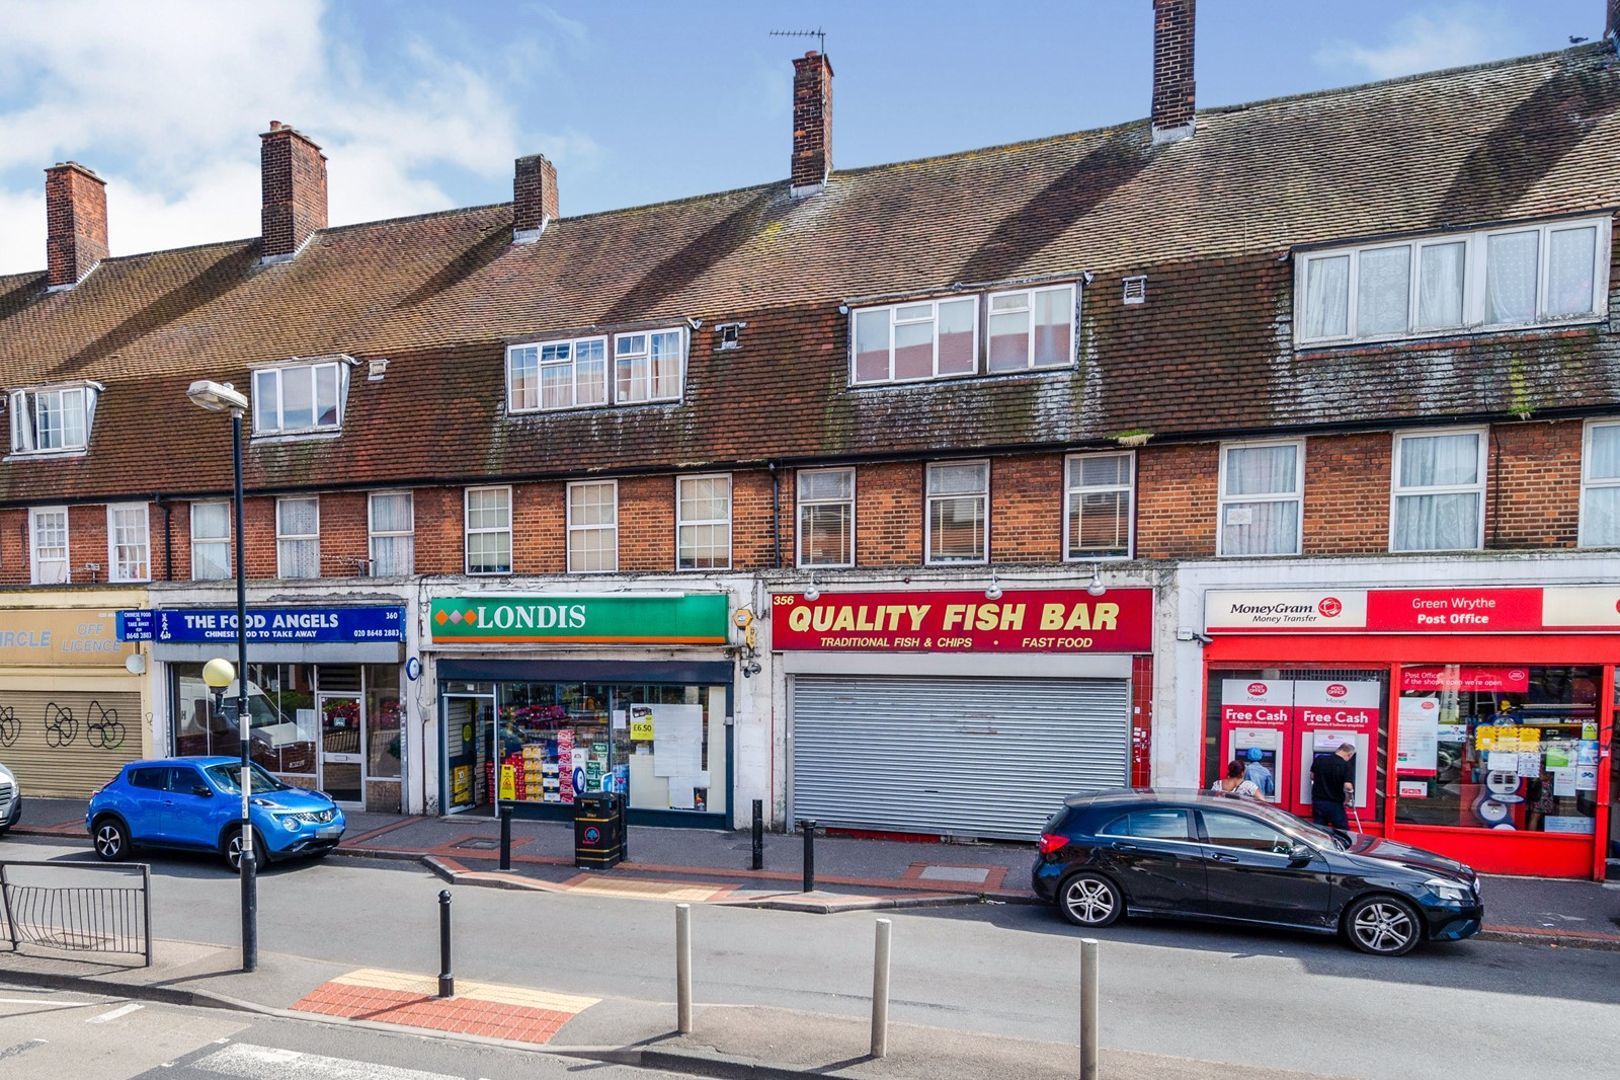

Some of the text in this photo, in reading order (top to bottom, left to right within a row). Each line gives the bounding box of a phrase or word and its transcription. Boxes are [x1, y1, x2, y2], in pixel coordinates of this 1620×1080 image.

[773, 595, 794, 606] 356
[1412, 598, 1496, 611] Green Wrythe
[1230, 603, 1313, 616] MoneyGram
[184, 614, 339, 628] THE FOOD ANGELS
[386, 612, 398, 620] 360
[476, 605, 586, 629] LONDIS
[788, 603, 1120, 632] QUALITY FISH BAR
[1252, 614, 1318, 624] Money Transfer
[1417, 613, 1490, 624] Post Office
[354, 630, 366, 638] 020
[366, 629, 382, 637] 8648
[384, 628, 400, 636] 2883
[62, 640, 122, 653] LICENCE
[820, 638, 972, 648] TRADITIONAL FISH & CHIPS
[1022, 638, 1093, 648] FAST FOOD
[1226, 708, 1288, 721] Free Cash
[1304, 710, 1368, 723] Free Cash
[633, 724, 652, 732] £6.50
